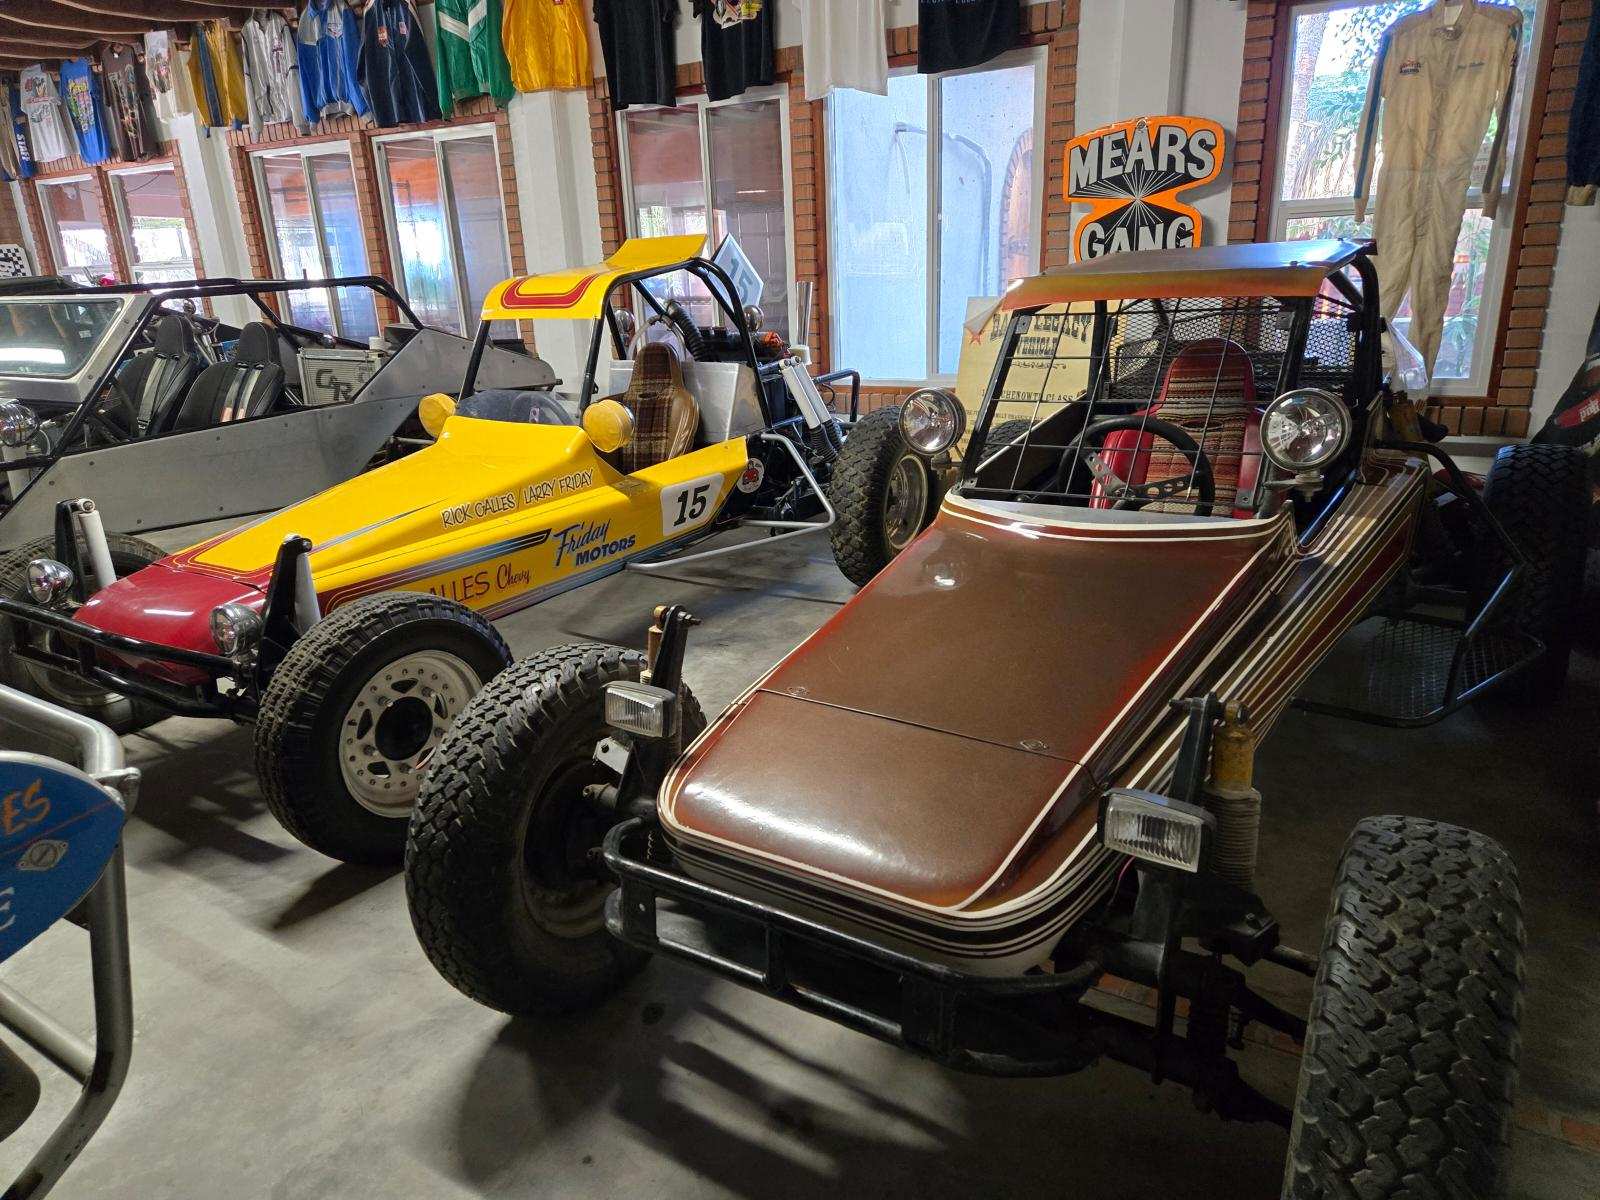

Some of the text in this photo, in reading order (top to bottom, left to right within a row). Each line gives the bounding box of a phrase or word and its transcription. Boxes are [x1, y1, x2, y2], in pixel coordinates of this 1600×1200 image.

[1069, 125, 1217, 195] MEARS
[1081, 216, 1194, 260] GANG
[441, 502, 474, 529] RICK
[474, 492, 516, 518] GALLES
[523, 478, 556, 504] LARRY
[559, 468, 594, 494] FRIDAY
[673, 483, 710, 526] 15
[553, 518, 611, 566] Friday
[575, 534, 636, 566] MOTORS
[496, 562, 530, 589] Chevy
